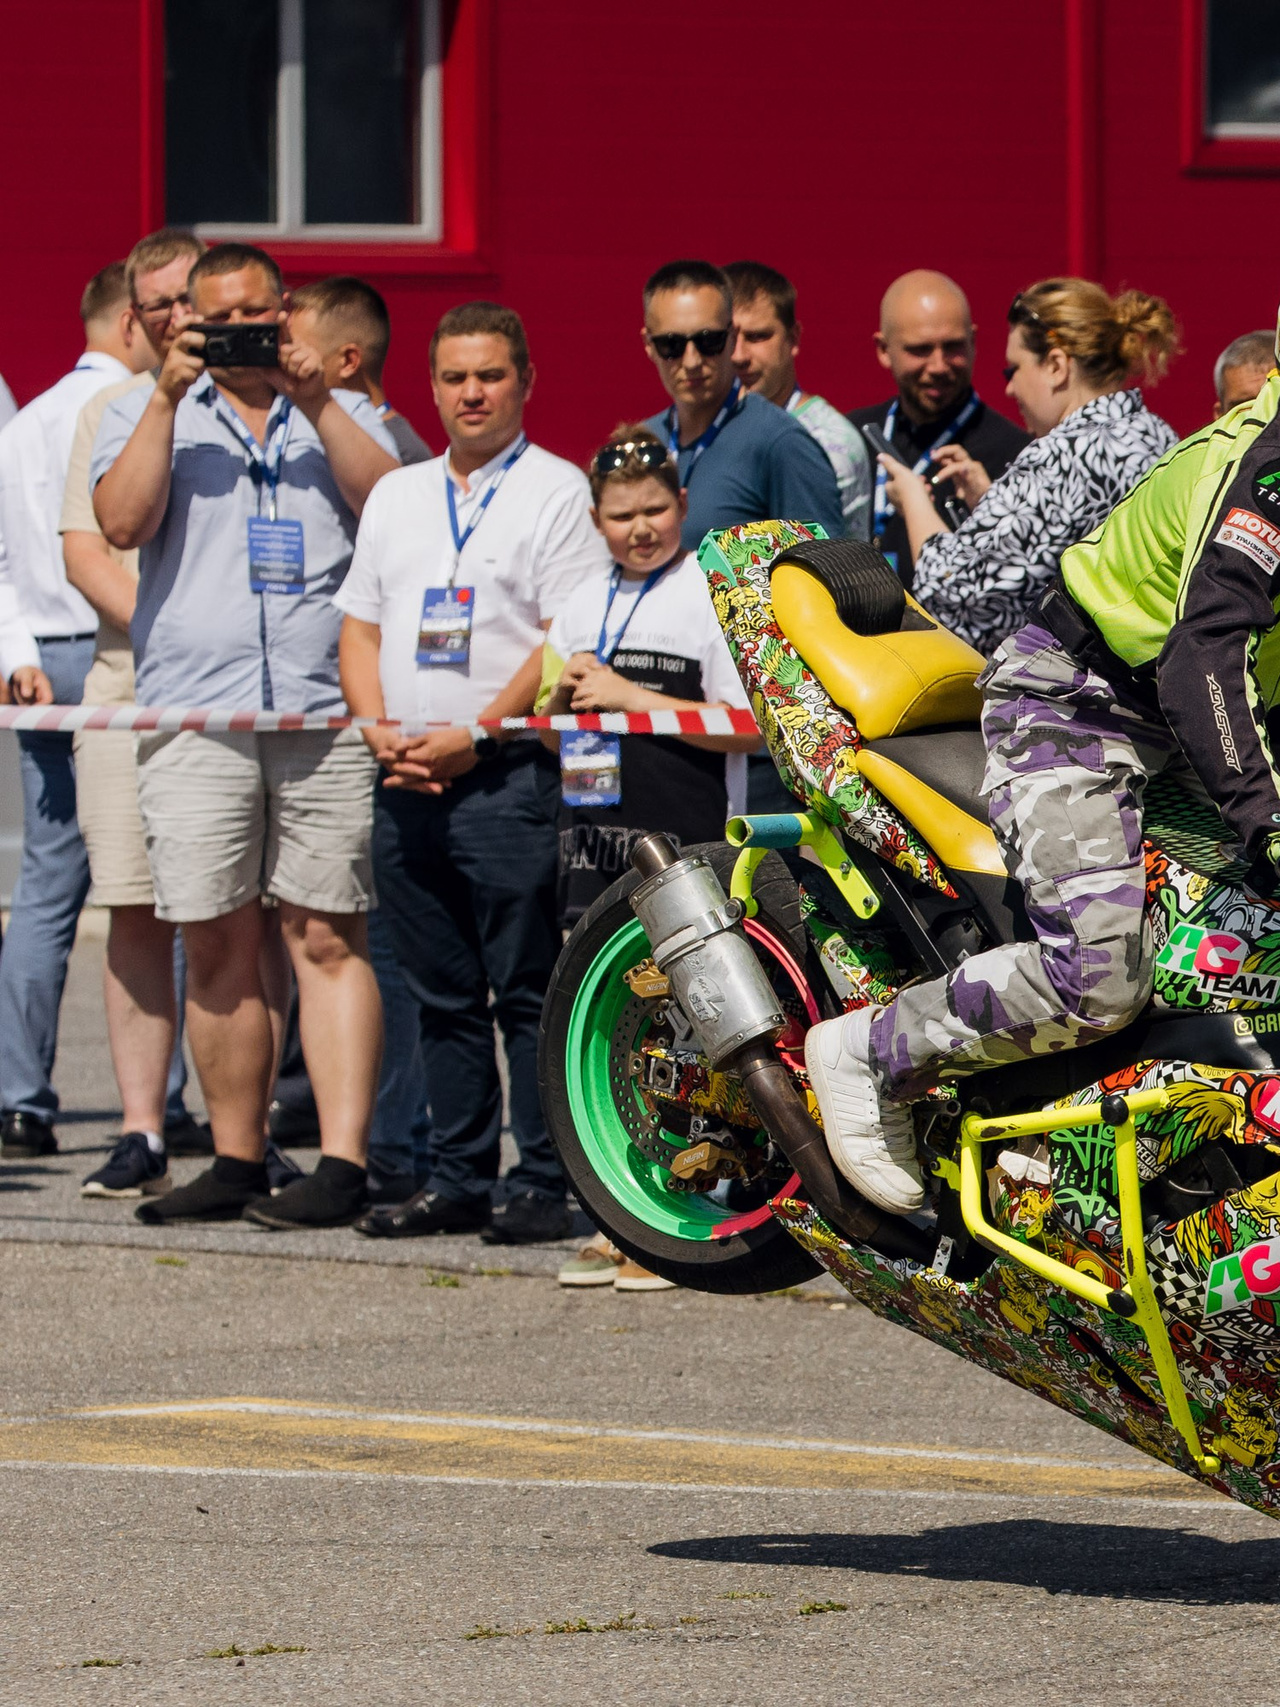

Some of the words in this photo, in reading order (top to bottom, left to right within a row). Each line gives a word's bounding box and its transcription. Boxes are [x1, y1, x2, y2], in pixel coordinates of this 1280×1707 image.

[1206, 672, 1243, 775] AGVSPORT
[1156, 925, 1242, 975] AG
[1199, 968, 1277, 1000] TEAM
